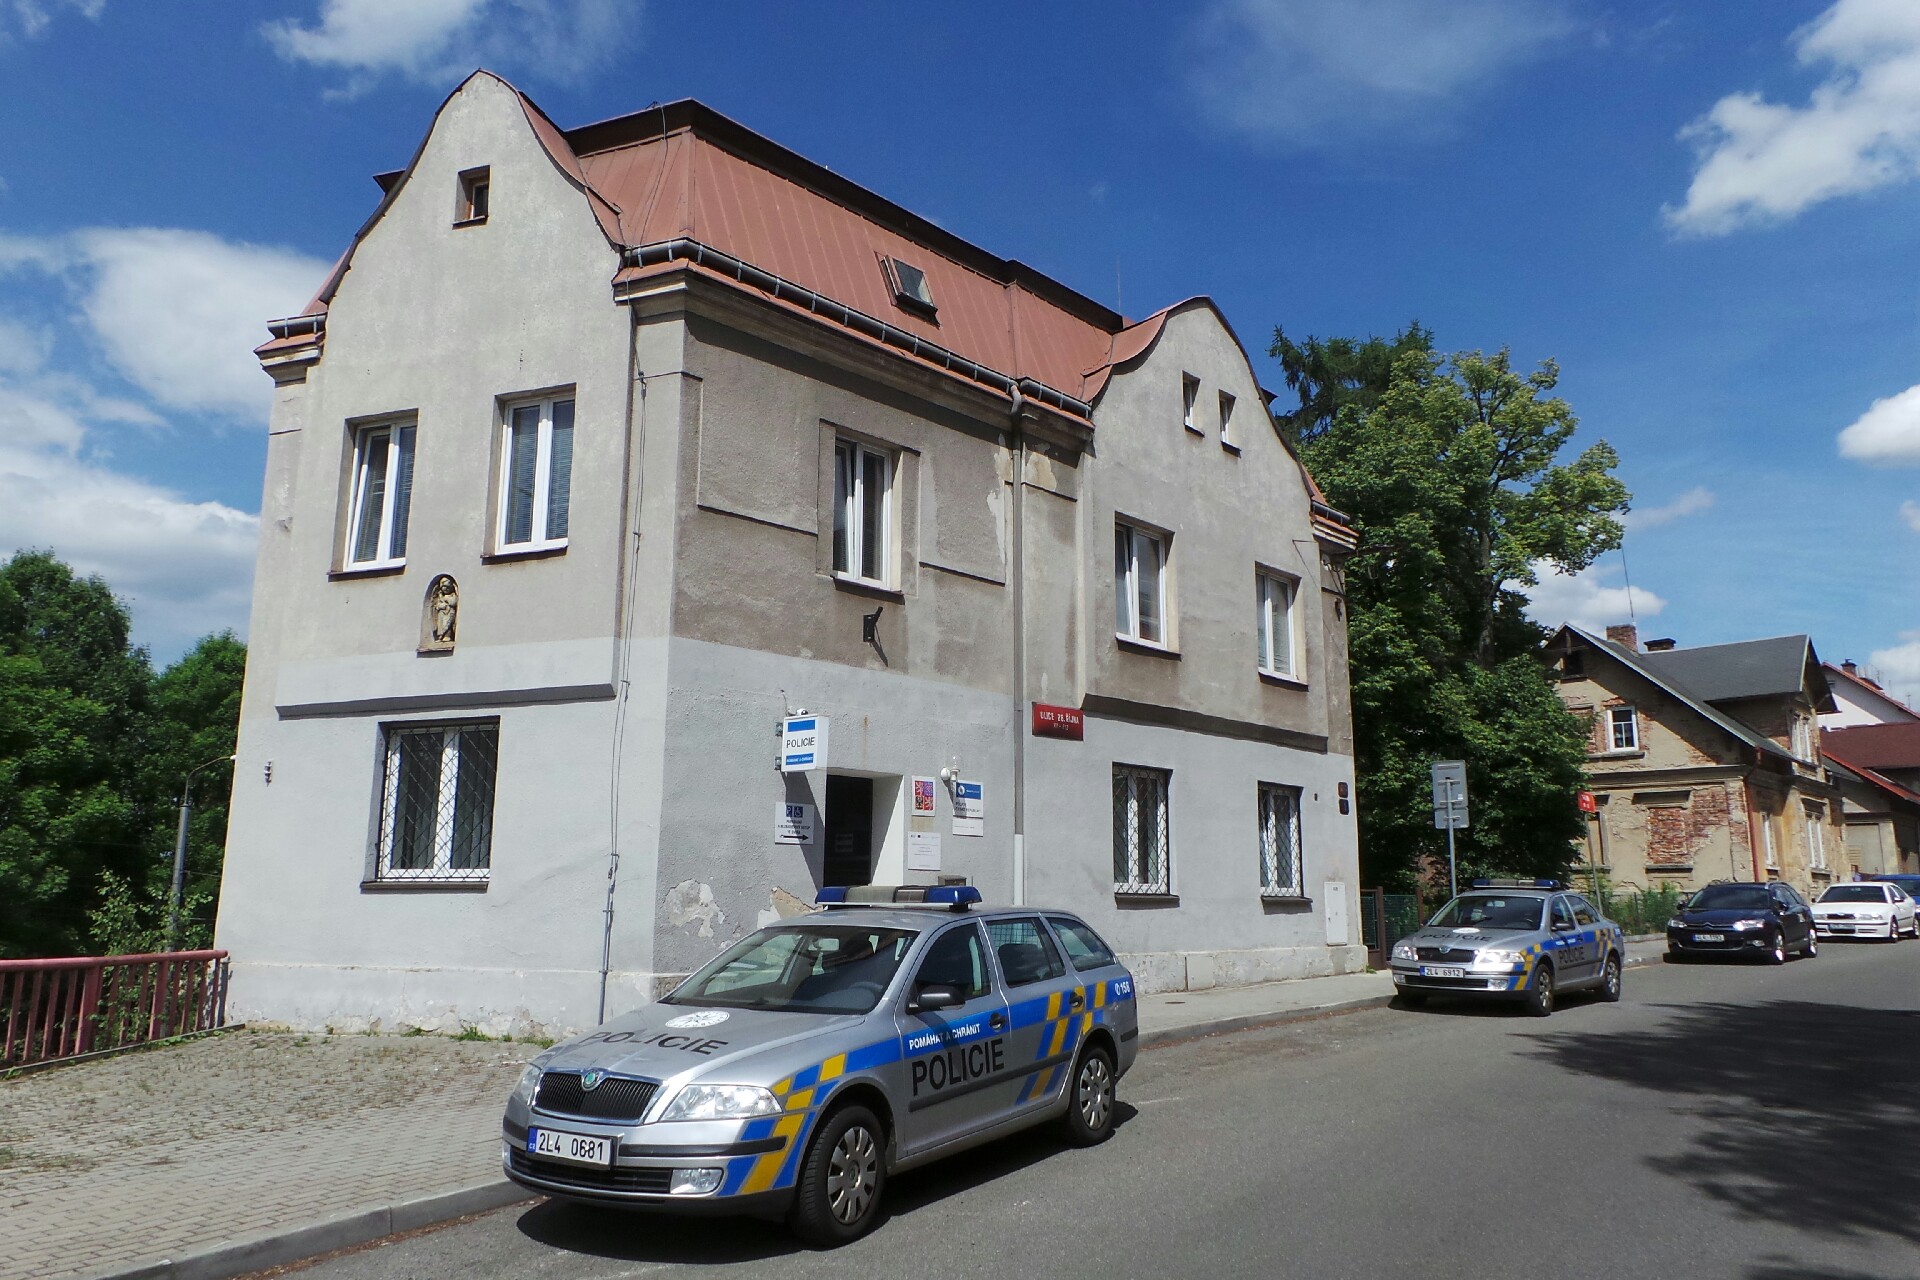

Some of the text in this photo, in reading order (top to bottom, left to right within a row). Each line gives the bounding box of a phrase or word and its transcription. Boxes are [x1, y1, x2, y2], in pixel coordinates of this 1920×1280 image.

[786, 737, 815, 748] POLICIE
[1426, 968, 1438, 976] 2L4
[578, 1031, 729, 1055] POLICIE
[909, 1033, 943, 1050] POMÁHAT
[952, 1023, 980, 1039] CHRÁNIT
[911, 1038, 1004, 1097] POLICIE
[528, 1142, 536, 1150] CZ
[539, 1132, 603, 1161] 2L4 0681
